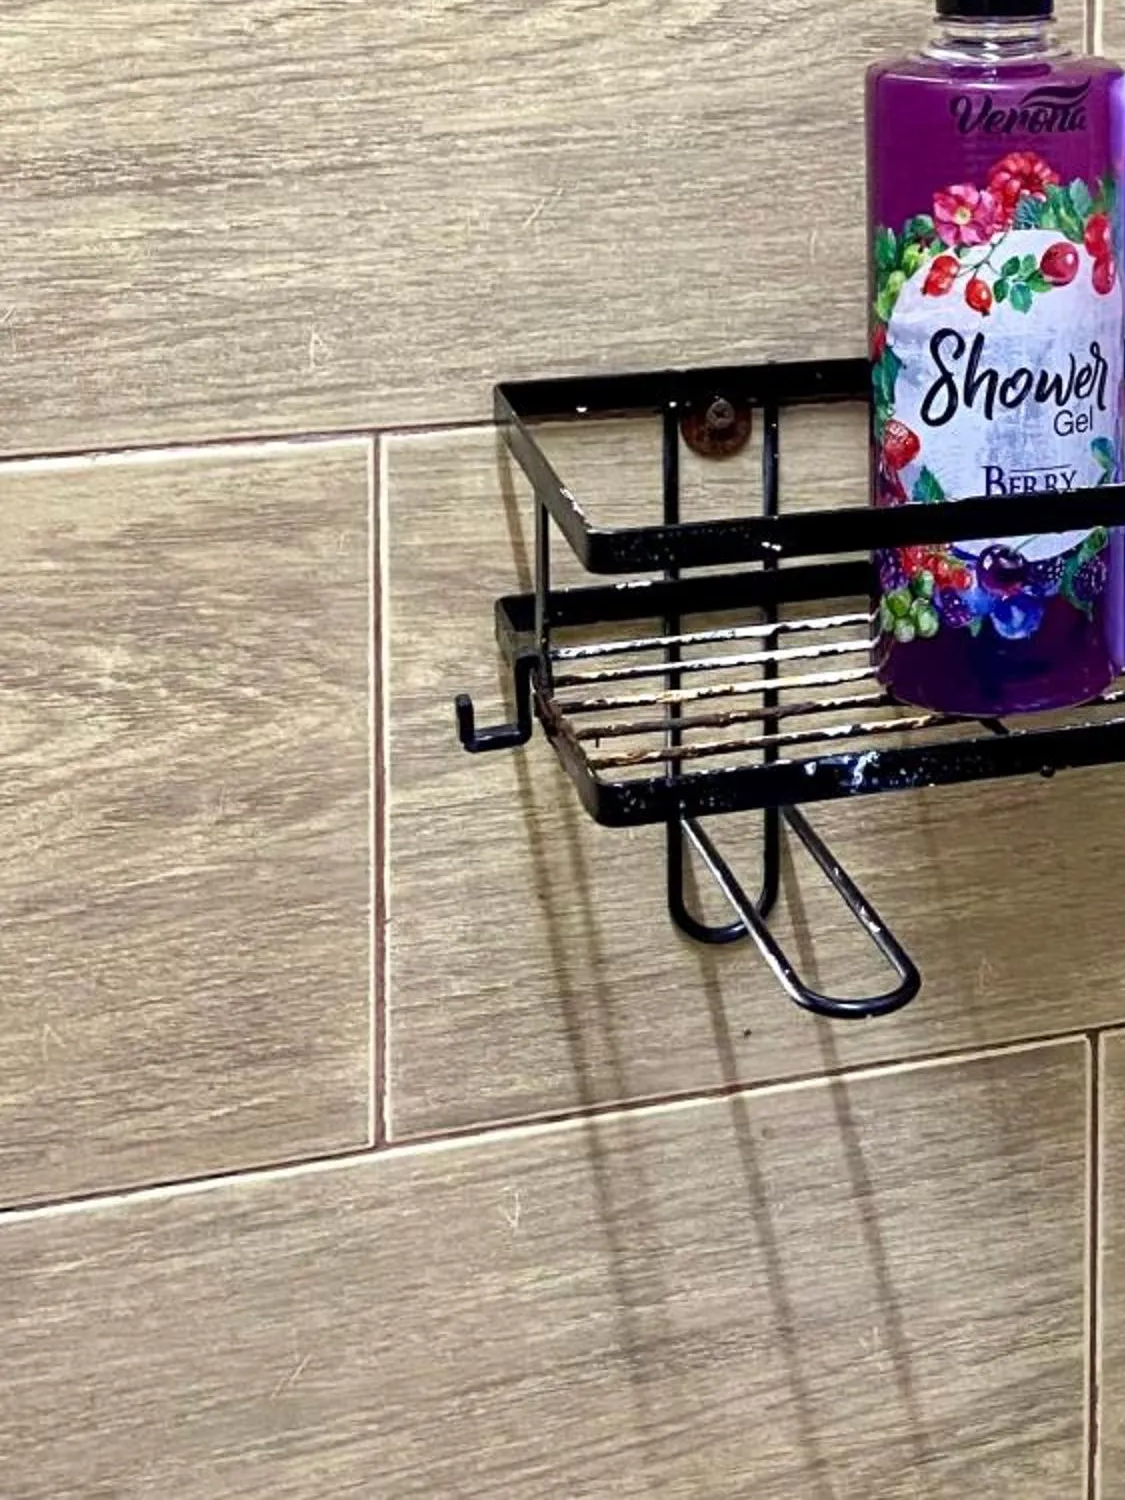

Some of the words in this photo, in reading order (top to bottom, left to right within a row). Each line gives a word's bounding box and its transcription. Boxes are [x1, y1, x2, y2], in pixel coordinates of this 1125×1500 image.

[920, 327, 1108, 427] Shower
[1053, 405, 1093, 437] Gel
[981, 465, 1077, 496] BERRY
